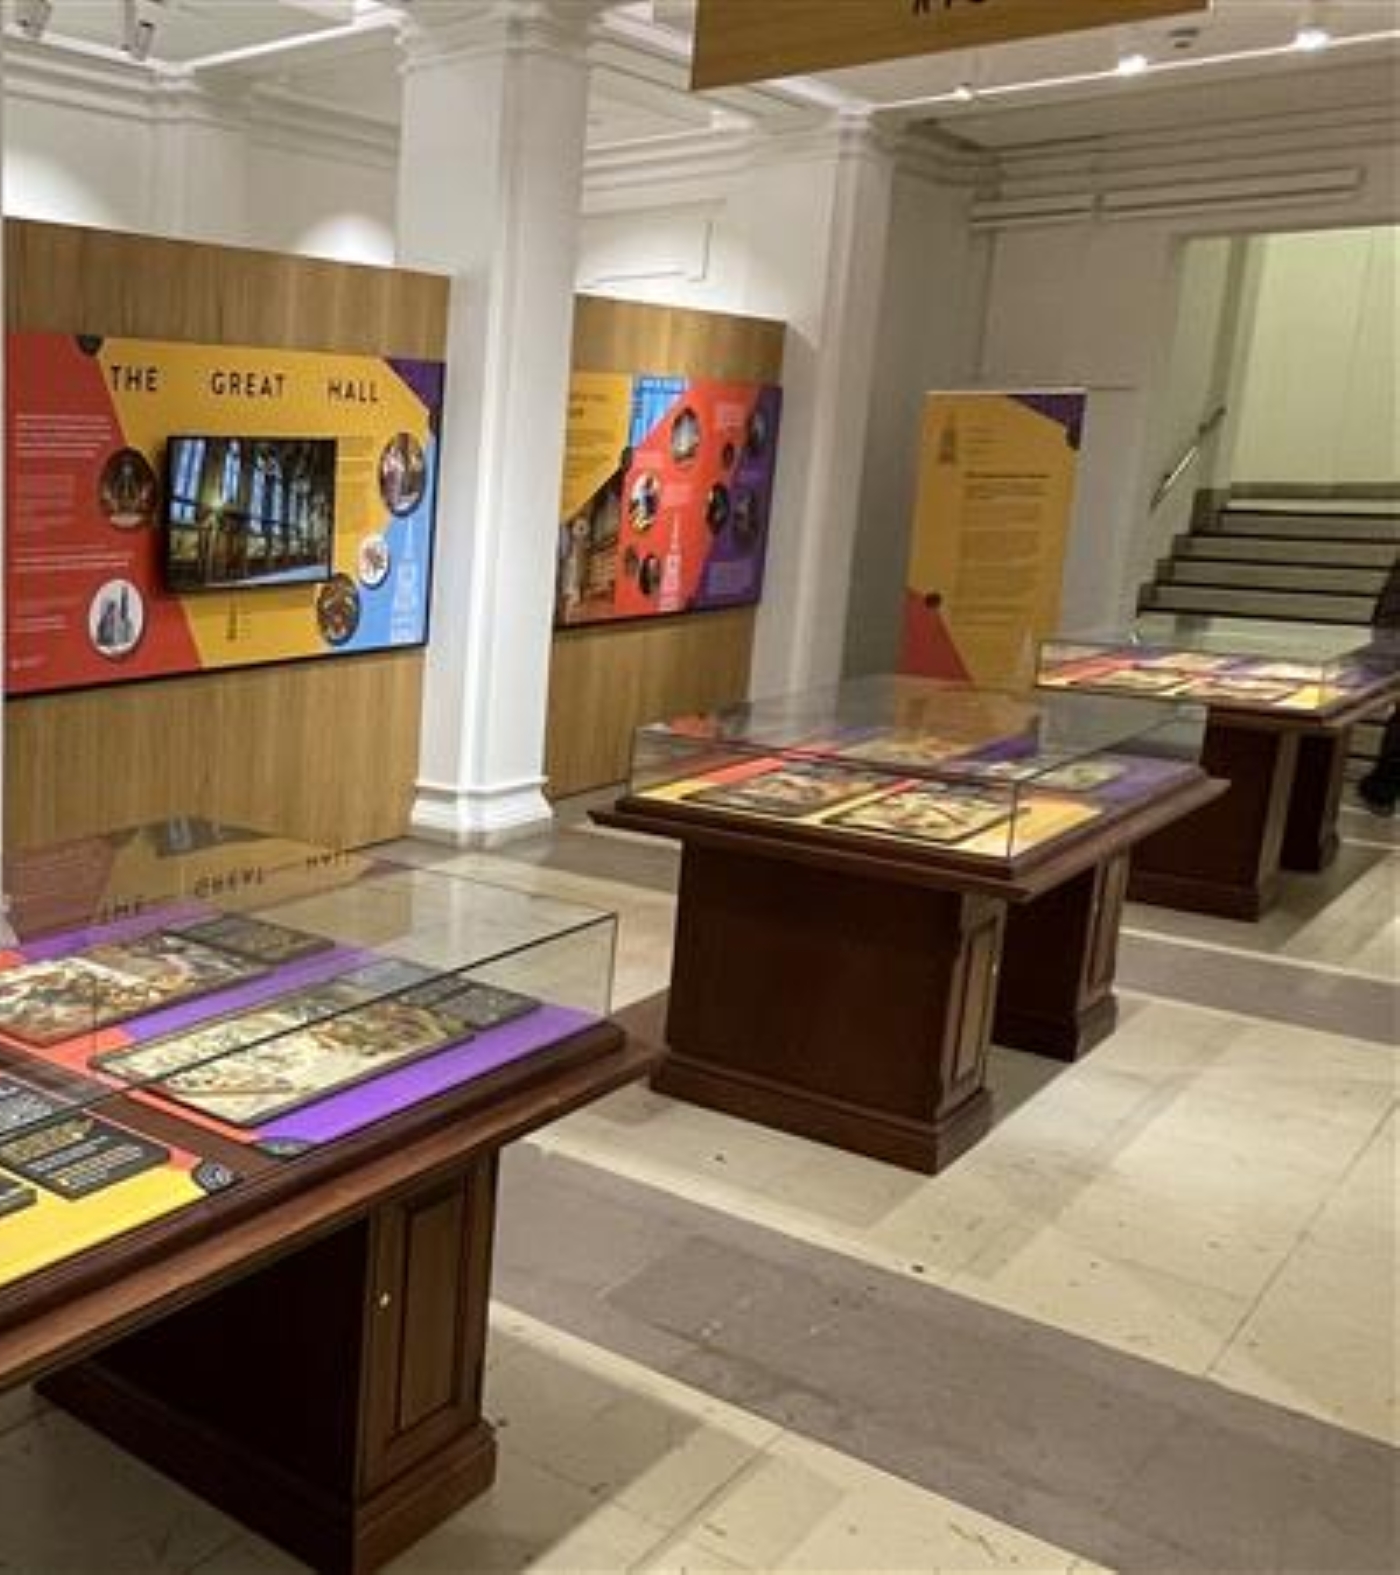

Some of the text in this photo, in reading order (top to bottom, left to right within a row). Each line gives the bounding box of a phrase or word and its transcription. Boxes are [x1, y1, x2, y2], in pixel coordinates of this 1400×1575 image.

[110, 365, 380, 403] THE GREAT HALL
